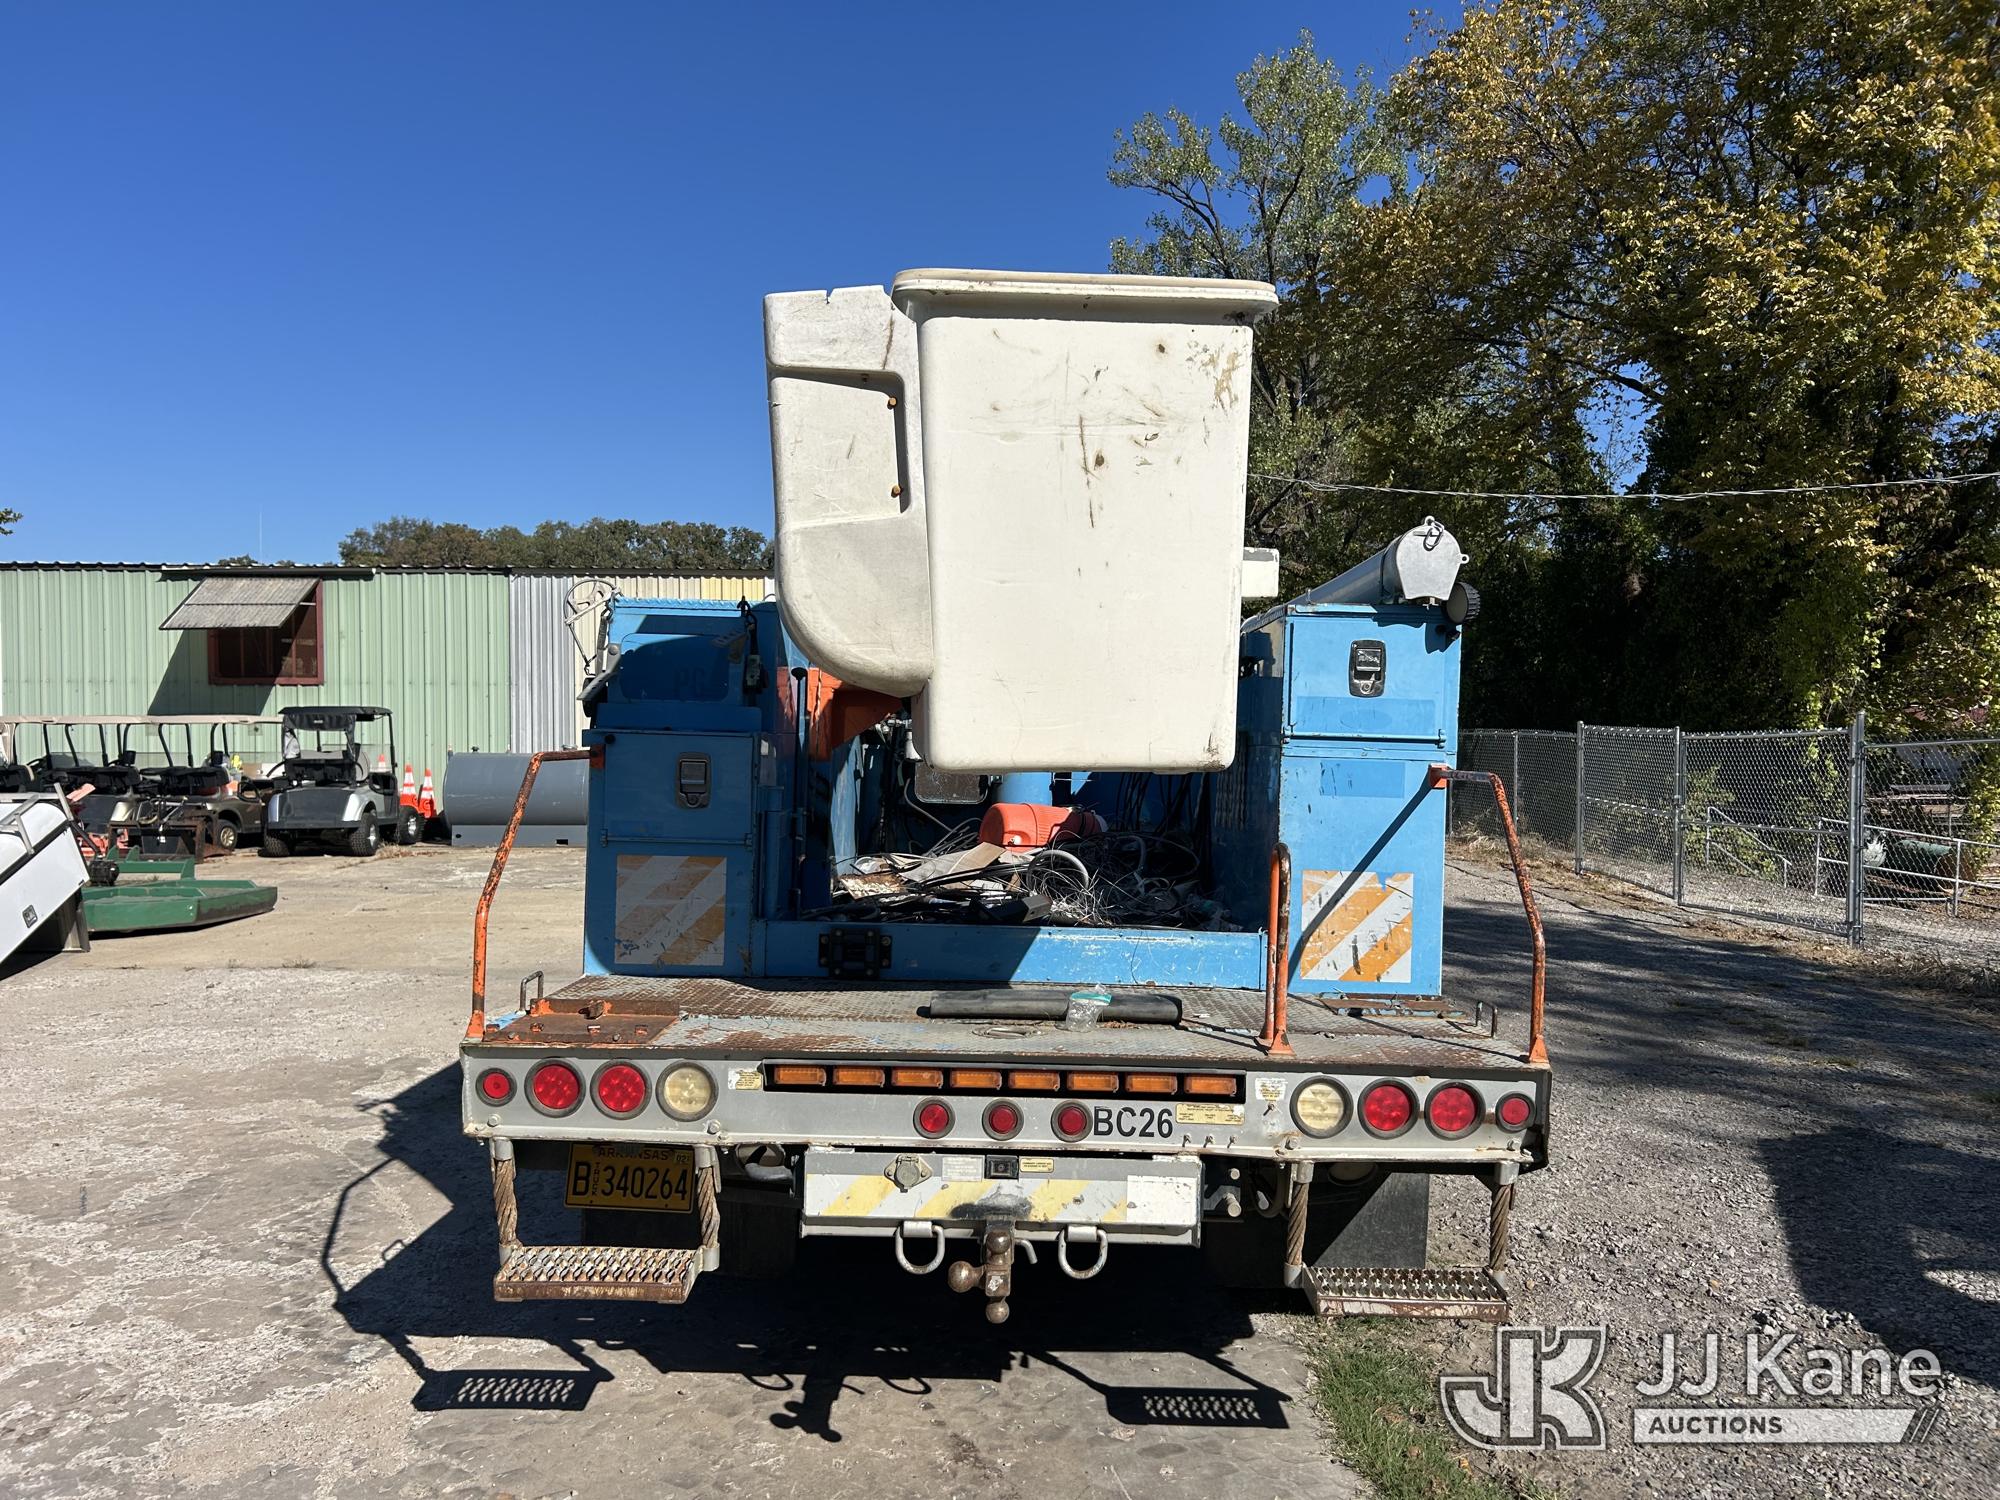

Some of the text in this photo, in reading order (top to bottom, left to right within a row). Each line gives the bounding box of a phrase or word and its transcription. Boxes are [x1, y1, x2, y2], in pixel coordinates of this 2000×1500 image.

[1093, 1105, 1173, 1138] BC26
[572, 1160, 688, 1201] B 340264
